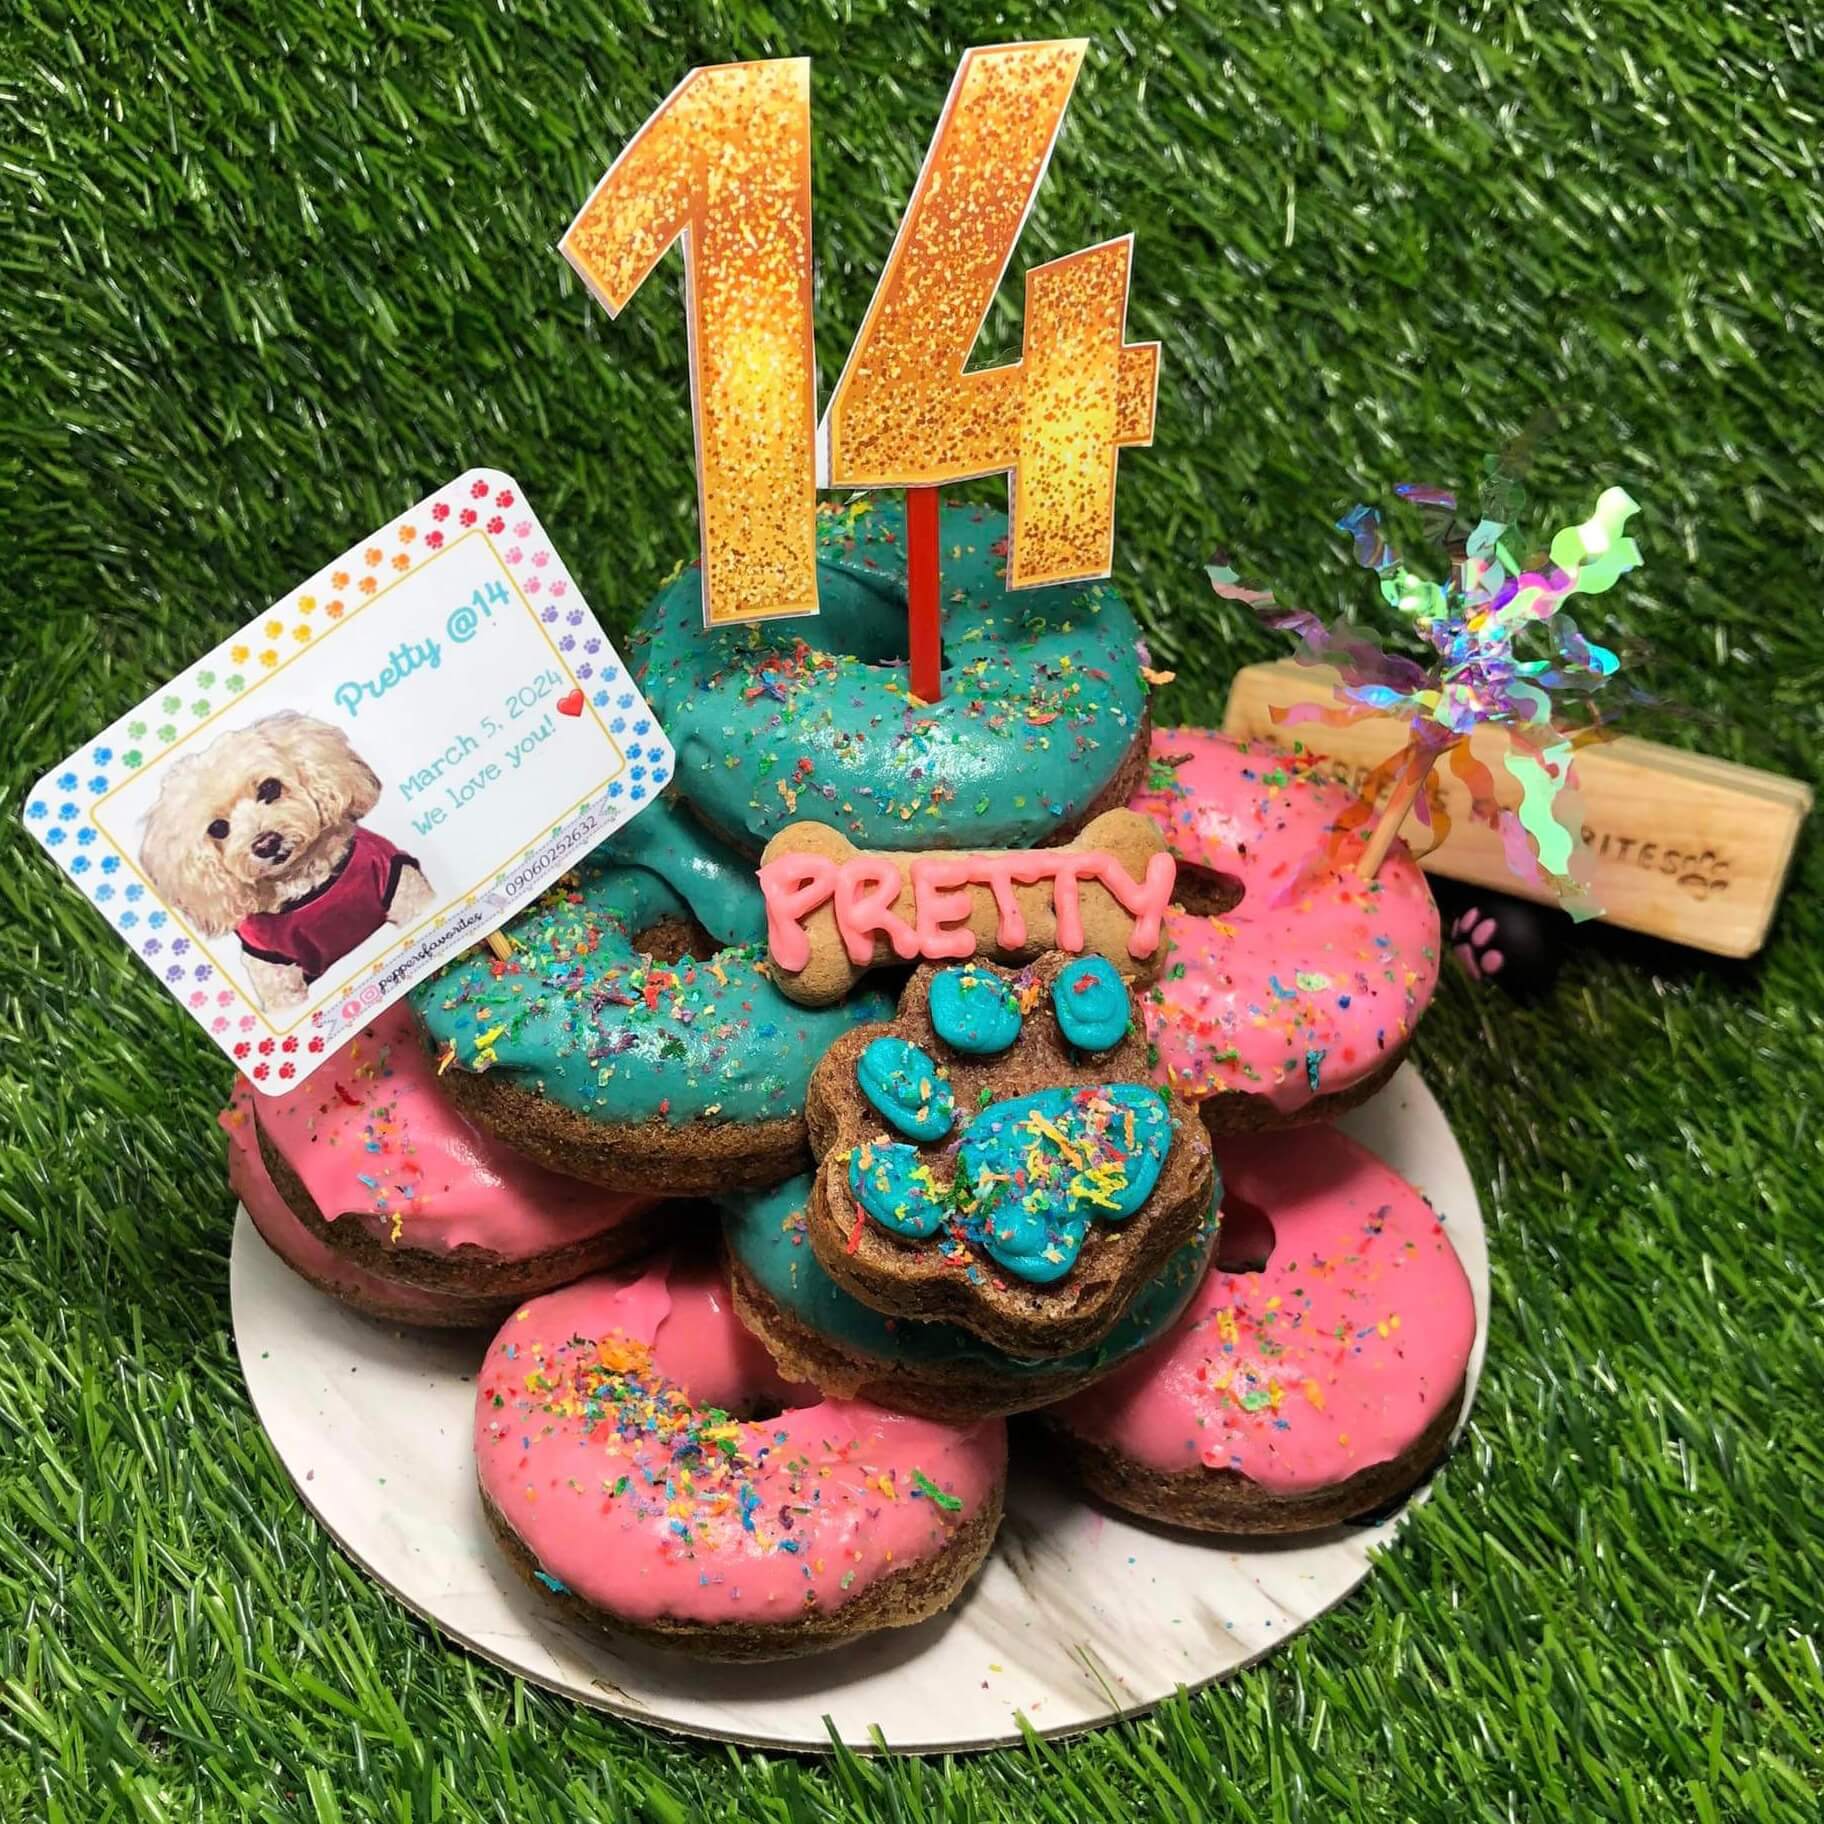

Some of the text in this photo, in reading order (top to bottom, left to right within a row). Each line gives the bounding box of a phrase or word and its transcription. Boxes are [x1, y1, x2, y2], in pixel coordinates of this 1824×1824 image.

[558, 38, 1162, 628] 14
[333, 580, 510, 718] Pretty @14
[399, 735, 480, 802] March
[505, 669, 564, 720] 2024
[446, 762, 502, 809] love
[504, 713, 557, 770] you!
[505, 815, 598, 897] 09060252632
[755, 850, 1178, 973] PRETTY
